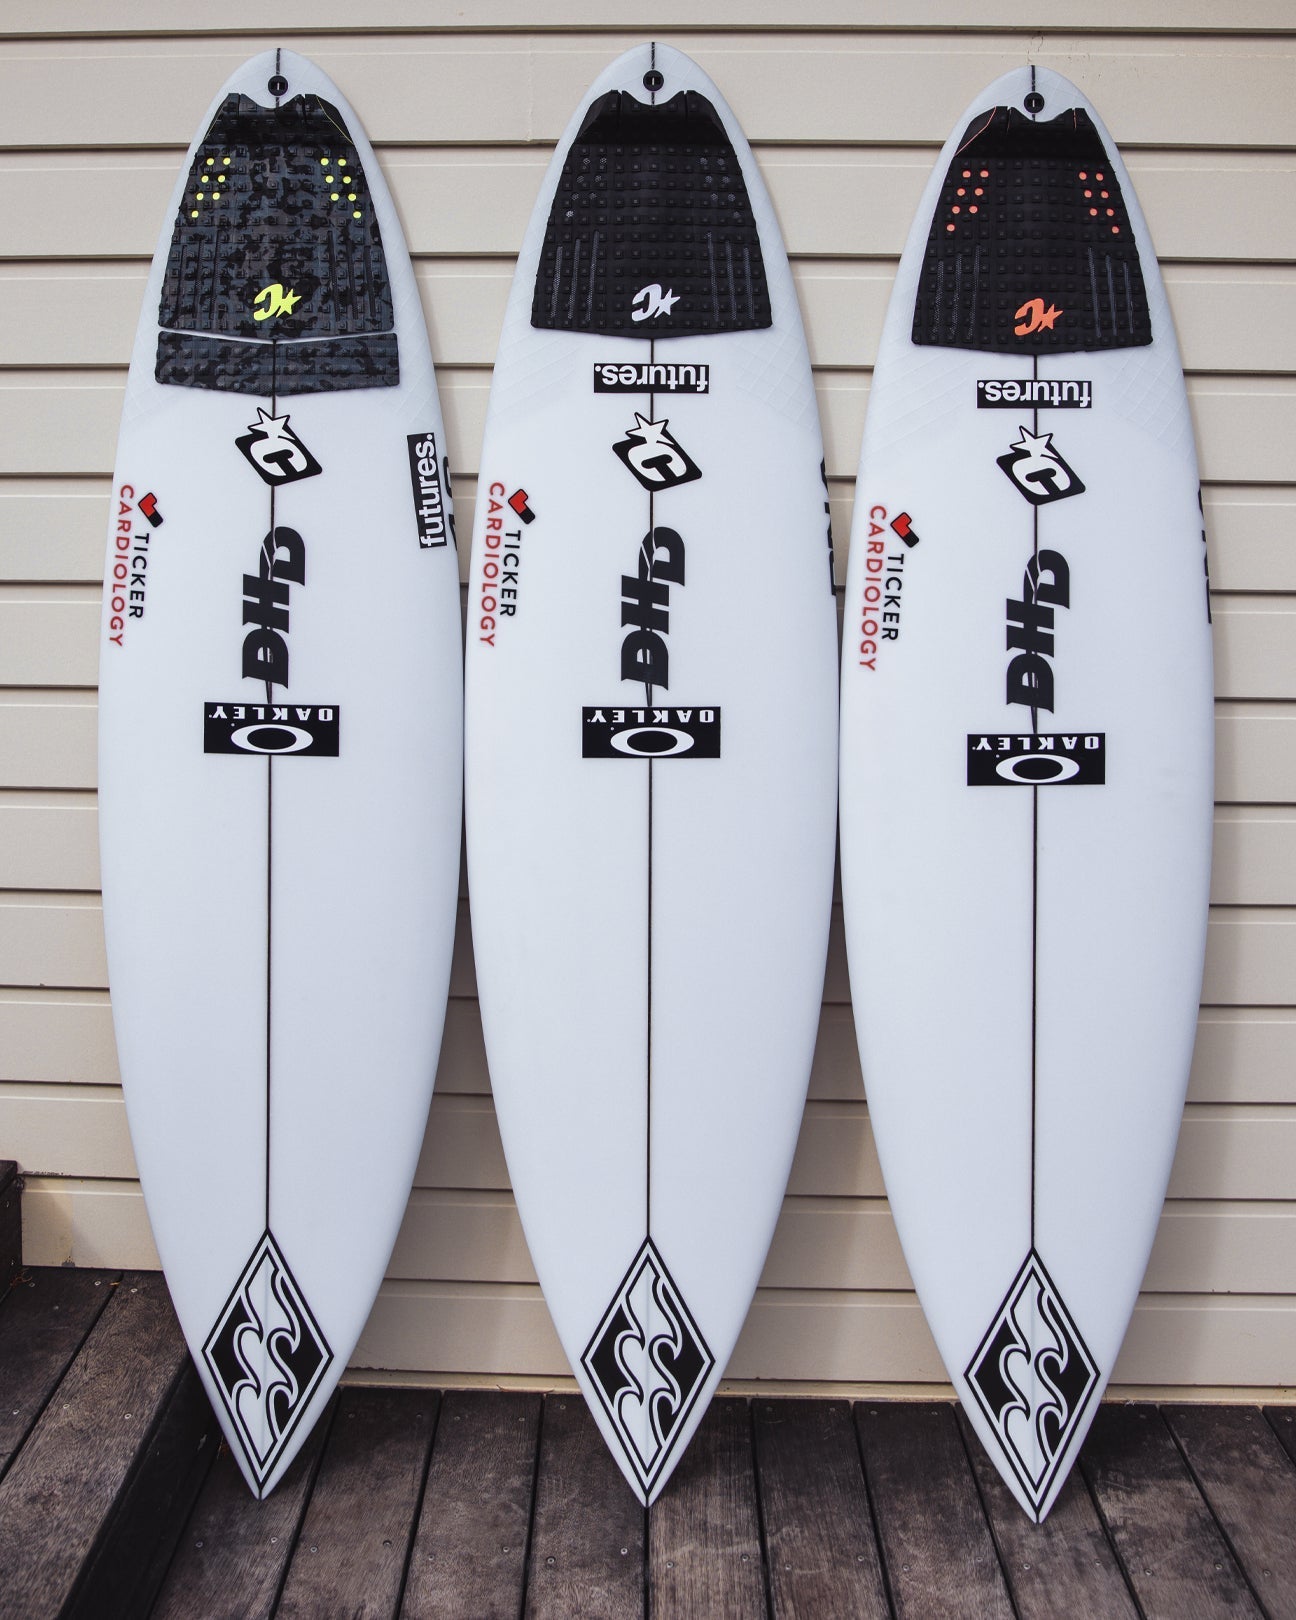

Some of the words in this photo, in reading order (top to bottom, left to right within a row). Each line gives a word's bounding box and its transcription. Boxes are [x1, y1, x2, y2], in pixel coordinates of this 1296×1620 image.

[595, 365, 708, 392] futures.
[978, 381, 1090, 407] futures.
[416, 433, 445, 546] futures.
[109, 484, 135, 647] CARDIOLOGY
[129, 532, 150, 619] TICKER
[242, 526, 306, 689] DHD
[479, 482, 505, 647] CARDIOLOGY
[499, 530, 522, 616] TICKER
[621, 526, 686, 691] DHD
[859, 505, 887, 671] CARDIOLOGY
[881, 553, 905, 641] TICKER
[1006, 549, 1070, 714] DHD
[209, 706, 333, 721] OAKLEY
[587, 709, 715, 724] OAKLEY
[972, 736, 1099, 750] OAKLEY
